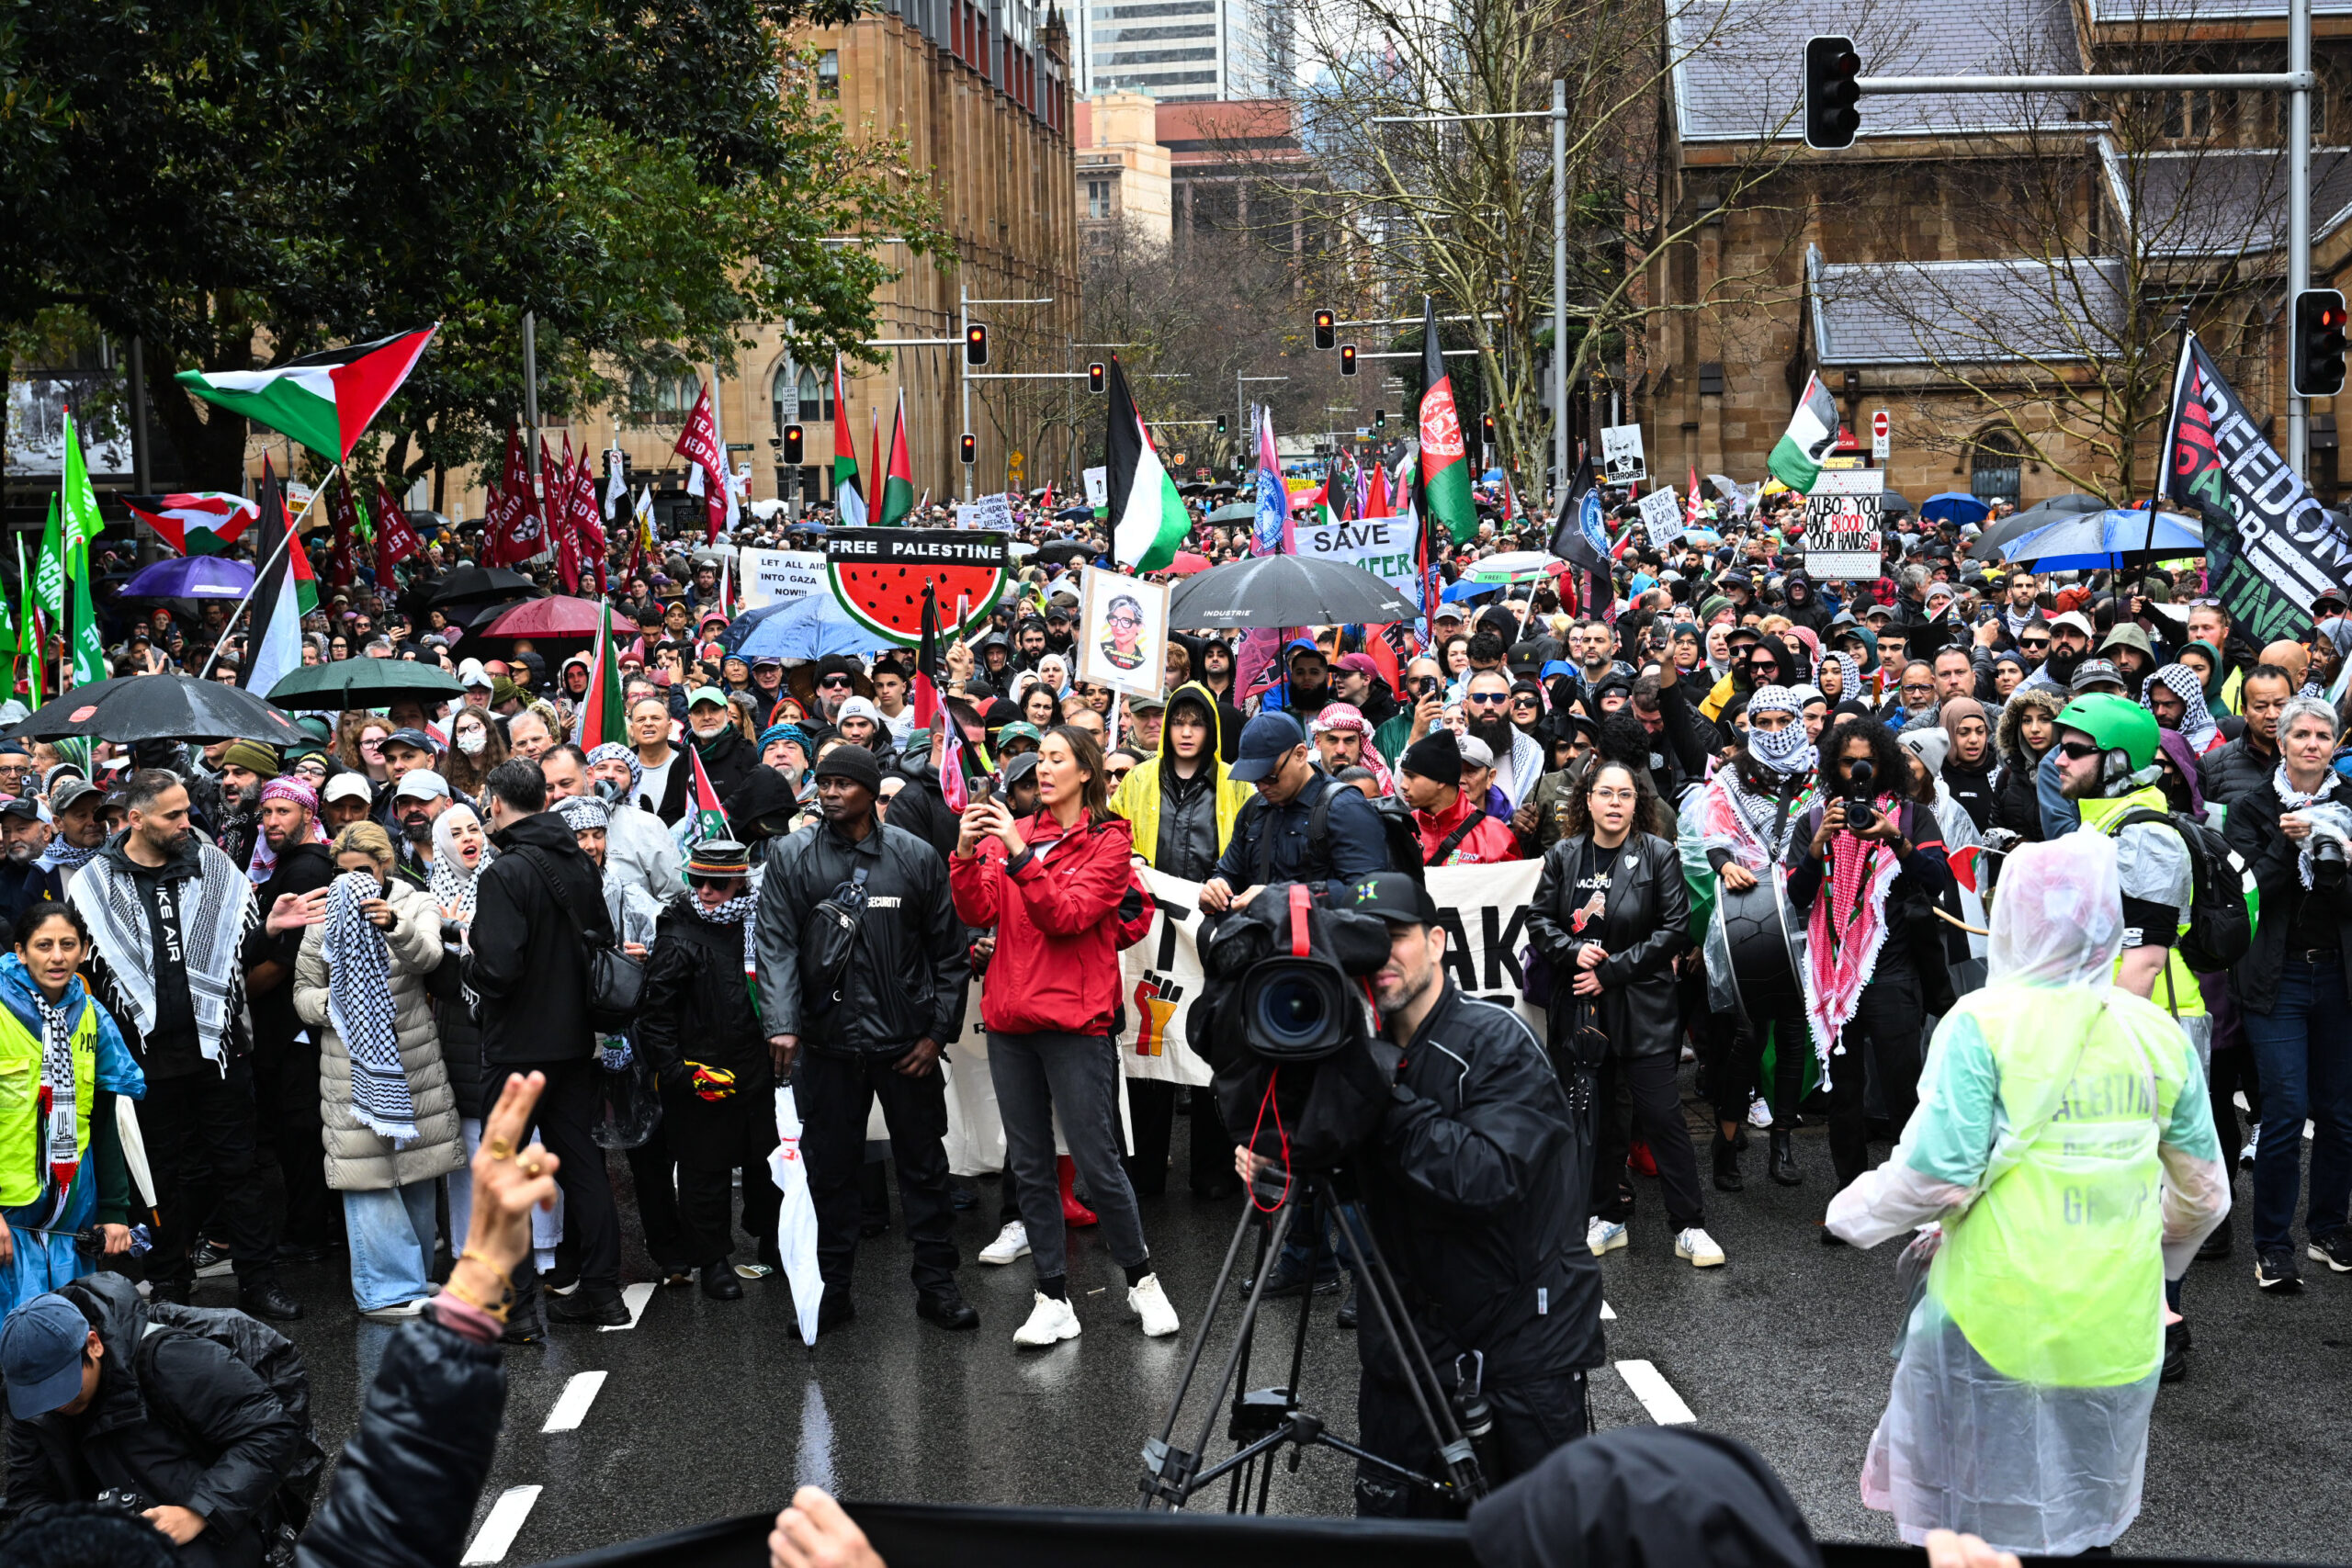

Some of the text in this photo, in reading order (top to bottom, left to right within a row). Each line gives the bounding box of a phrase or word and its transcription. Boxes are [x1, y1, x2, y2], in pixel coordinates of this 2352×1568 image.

[1607, 468, 1645, 482] TERRORIST
[978, 496, 1006, 507] BOMBING
[1853, 496, 1883, 514] YOU
[979, 504, 1008, 515] CHILDREN
[983, 517, 1009, 527] DEFENCE
[1806, 514, 1883, 533] HAVE BLOOD ON
[1314, 524, 1391, 552] SAVE
[1652, 518, 1681, 544] REALLY?
[1806, 532, 1871, 550] YOUR HANDS
[829, 540, 1002, 559] FREE PALESTINE
[761, 558, 827, 570] LET ALL AID
[761, 573, 817, 584] INTO GAZA
[775, 588, 808, 597] NOW!!!
[866, 897, 902, 908] SECURITY
[163, 925, 181, 963] AIR
